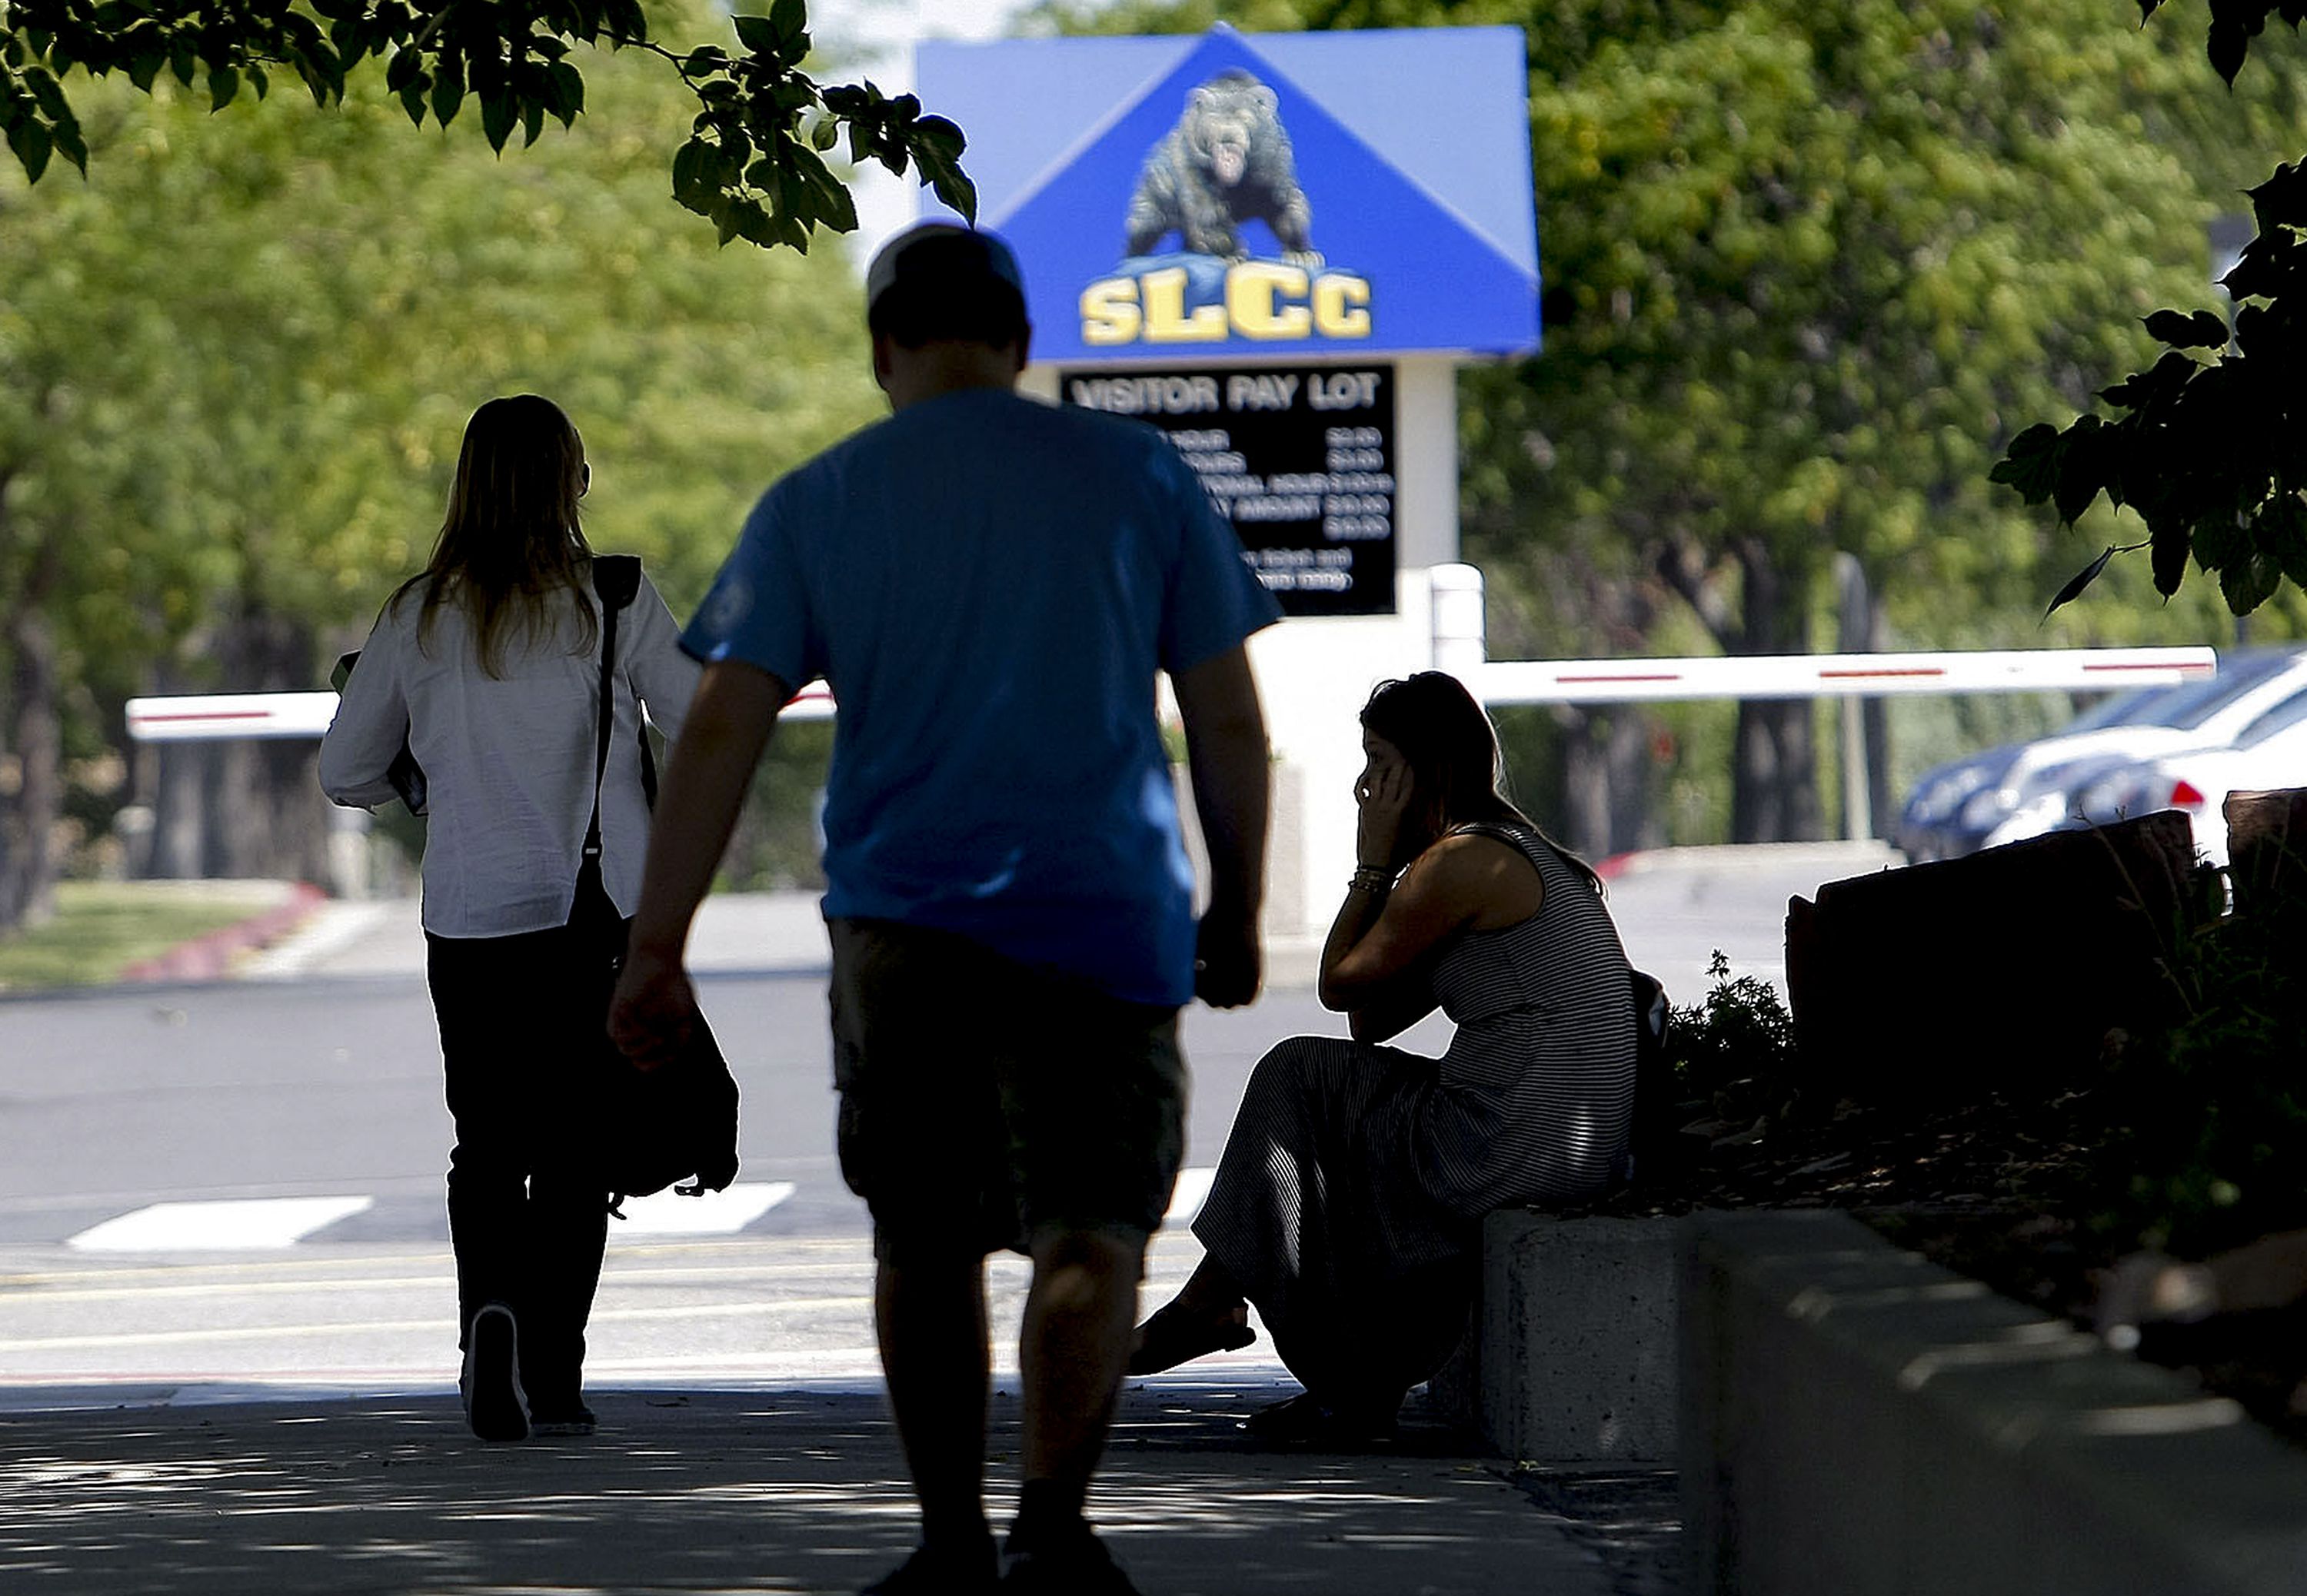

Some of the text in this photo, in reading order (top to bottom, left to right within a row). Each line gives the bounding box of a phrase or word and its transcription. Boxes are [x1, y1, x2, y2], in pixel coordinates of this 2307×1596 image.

[1080, 262, 1371, 345] SLCC
[1073, 373, 1381, 414] VISITOR PAY LOT
